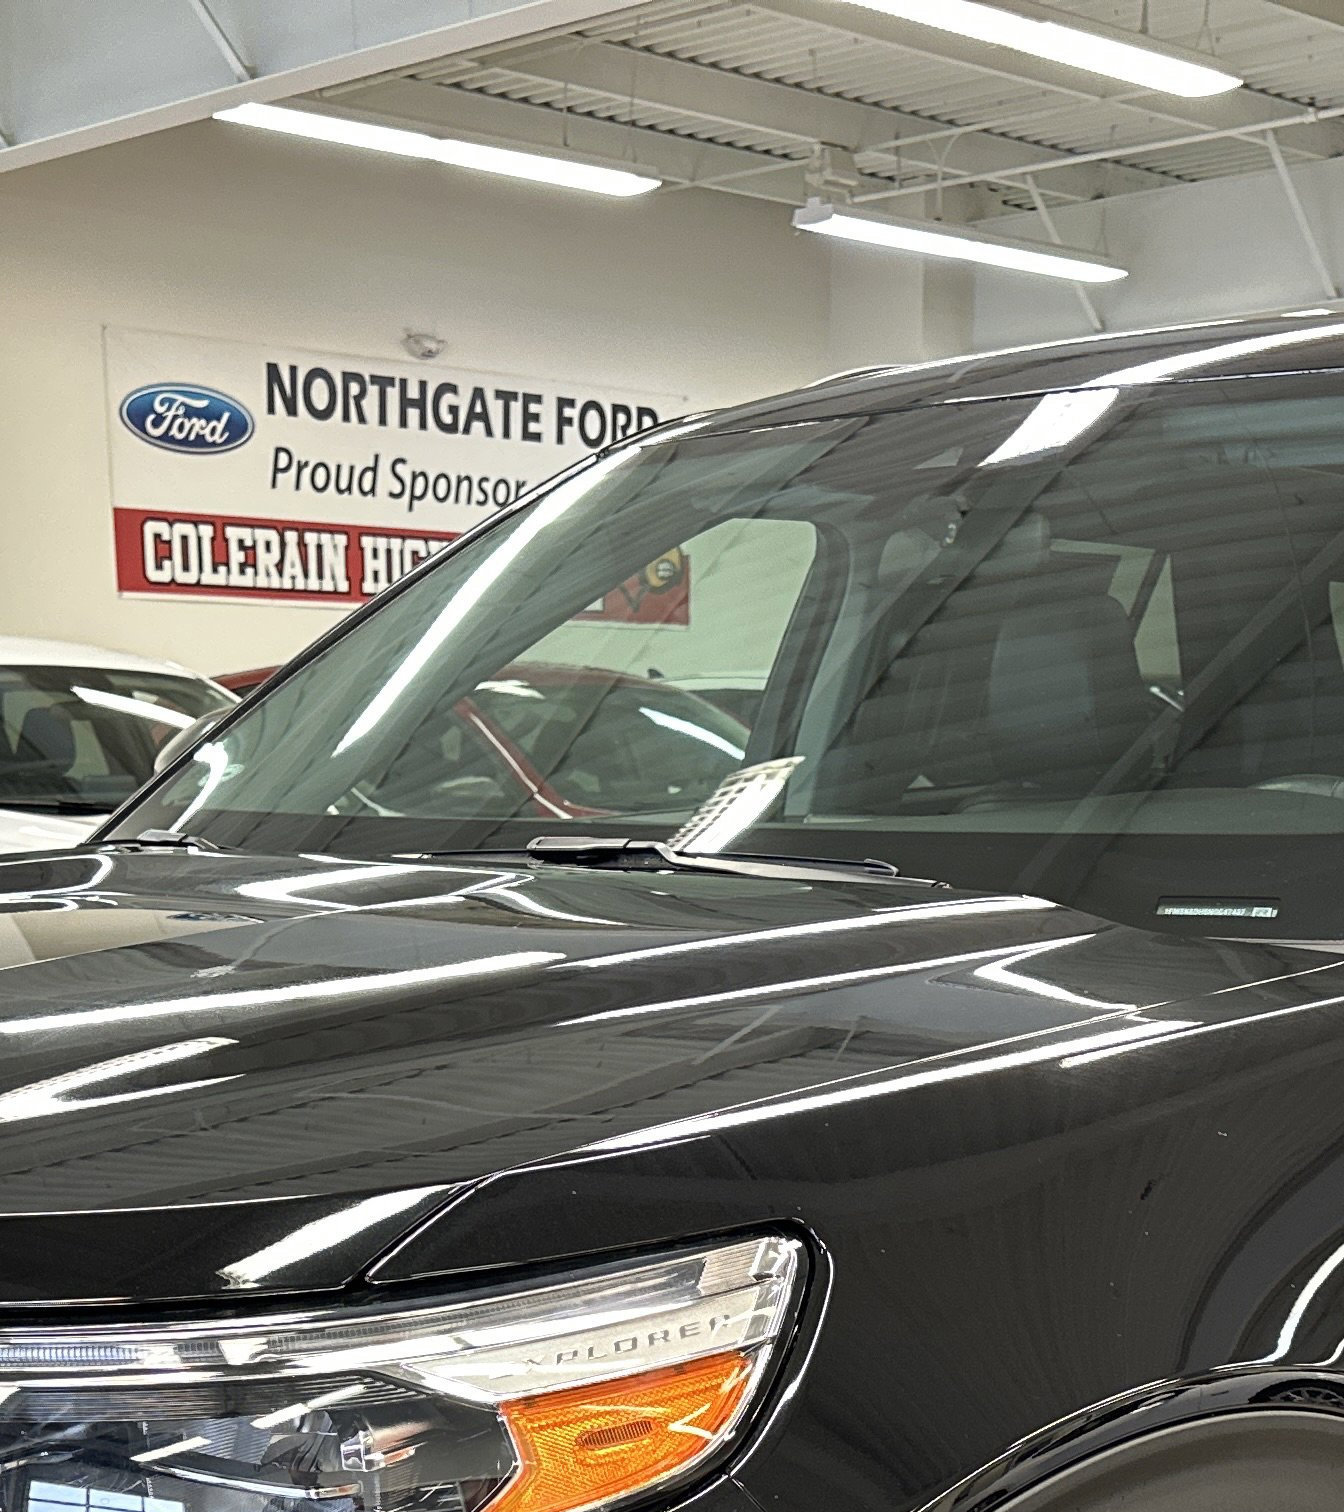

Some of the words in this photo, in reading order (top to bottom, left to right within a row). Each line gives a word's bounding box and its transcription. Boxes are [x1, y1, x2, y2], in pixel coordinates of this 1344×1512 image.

[144, 392, 232, 445] Ford
[265, 361, 543, 443] NORTHGATE
[271, 446, 380, 498] Proud
[389, 456, 528, 512] Sponsor
[142, 517, 351, 594] COLERAIN
[506, 1313, 731, 1371] XPLORER
